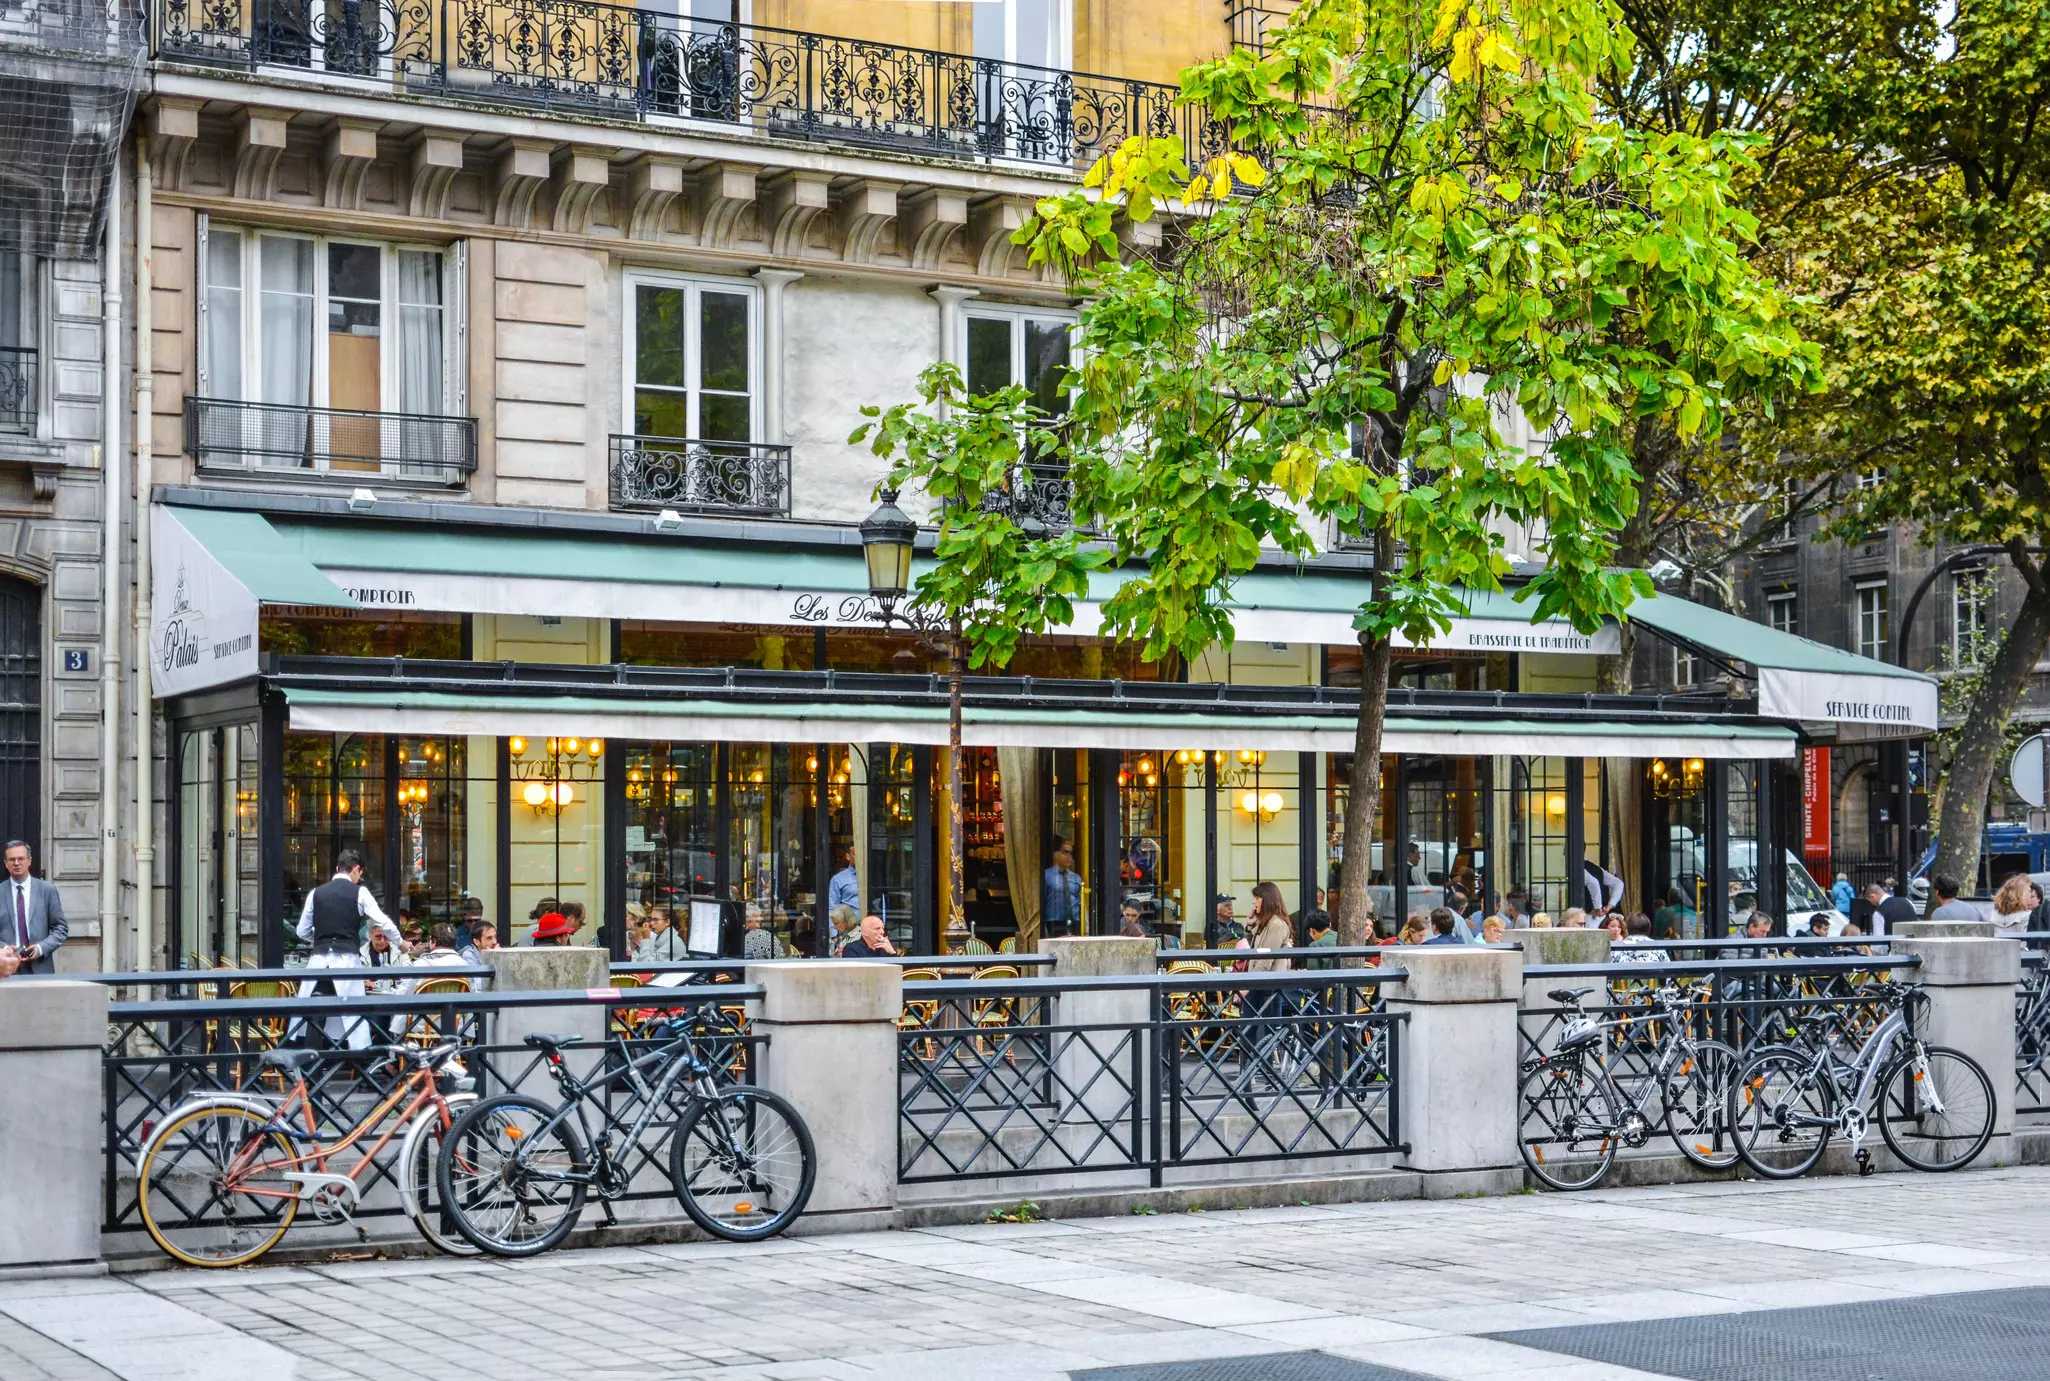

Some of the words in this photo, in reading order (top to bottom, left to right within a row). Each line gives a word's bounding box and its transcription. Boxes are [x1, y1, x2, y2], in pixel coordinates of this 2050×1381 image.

[789, 593, 829, 622] Les
[163, 619, 199, 672] Palais
[1469, 634, 1522, 647] BRASSERIE
[1525, 636, 1537, 647] DE
[1540, 637, 1592, 649] TRADITION
[71, 651, 82, 669] 3
[1826, 701, 1870, 719] SERVICE
[1873, 704, 1912, 721] CONTINU
